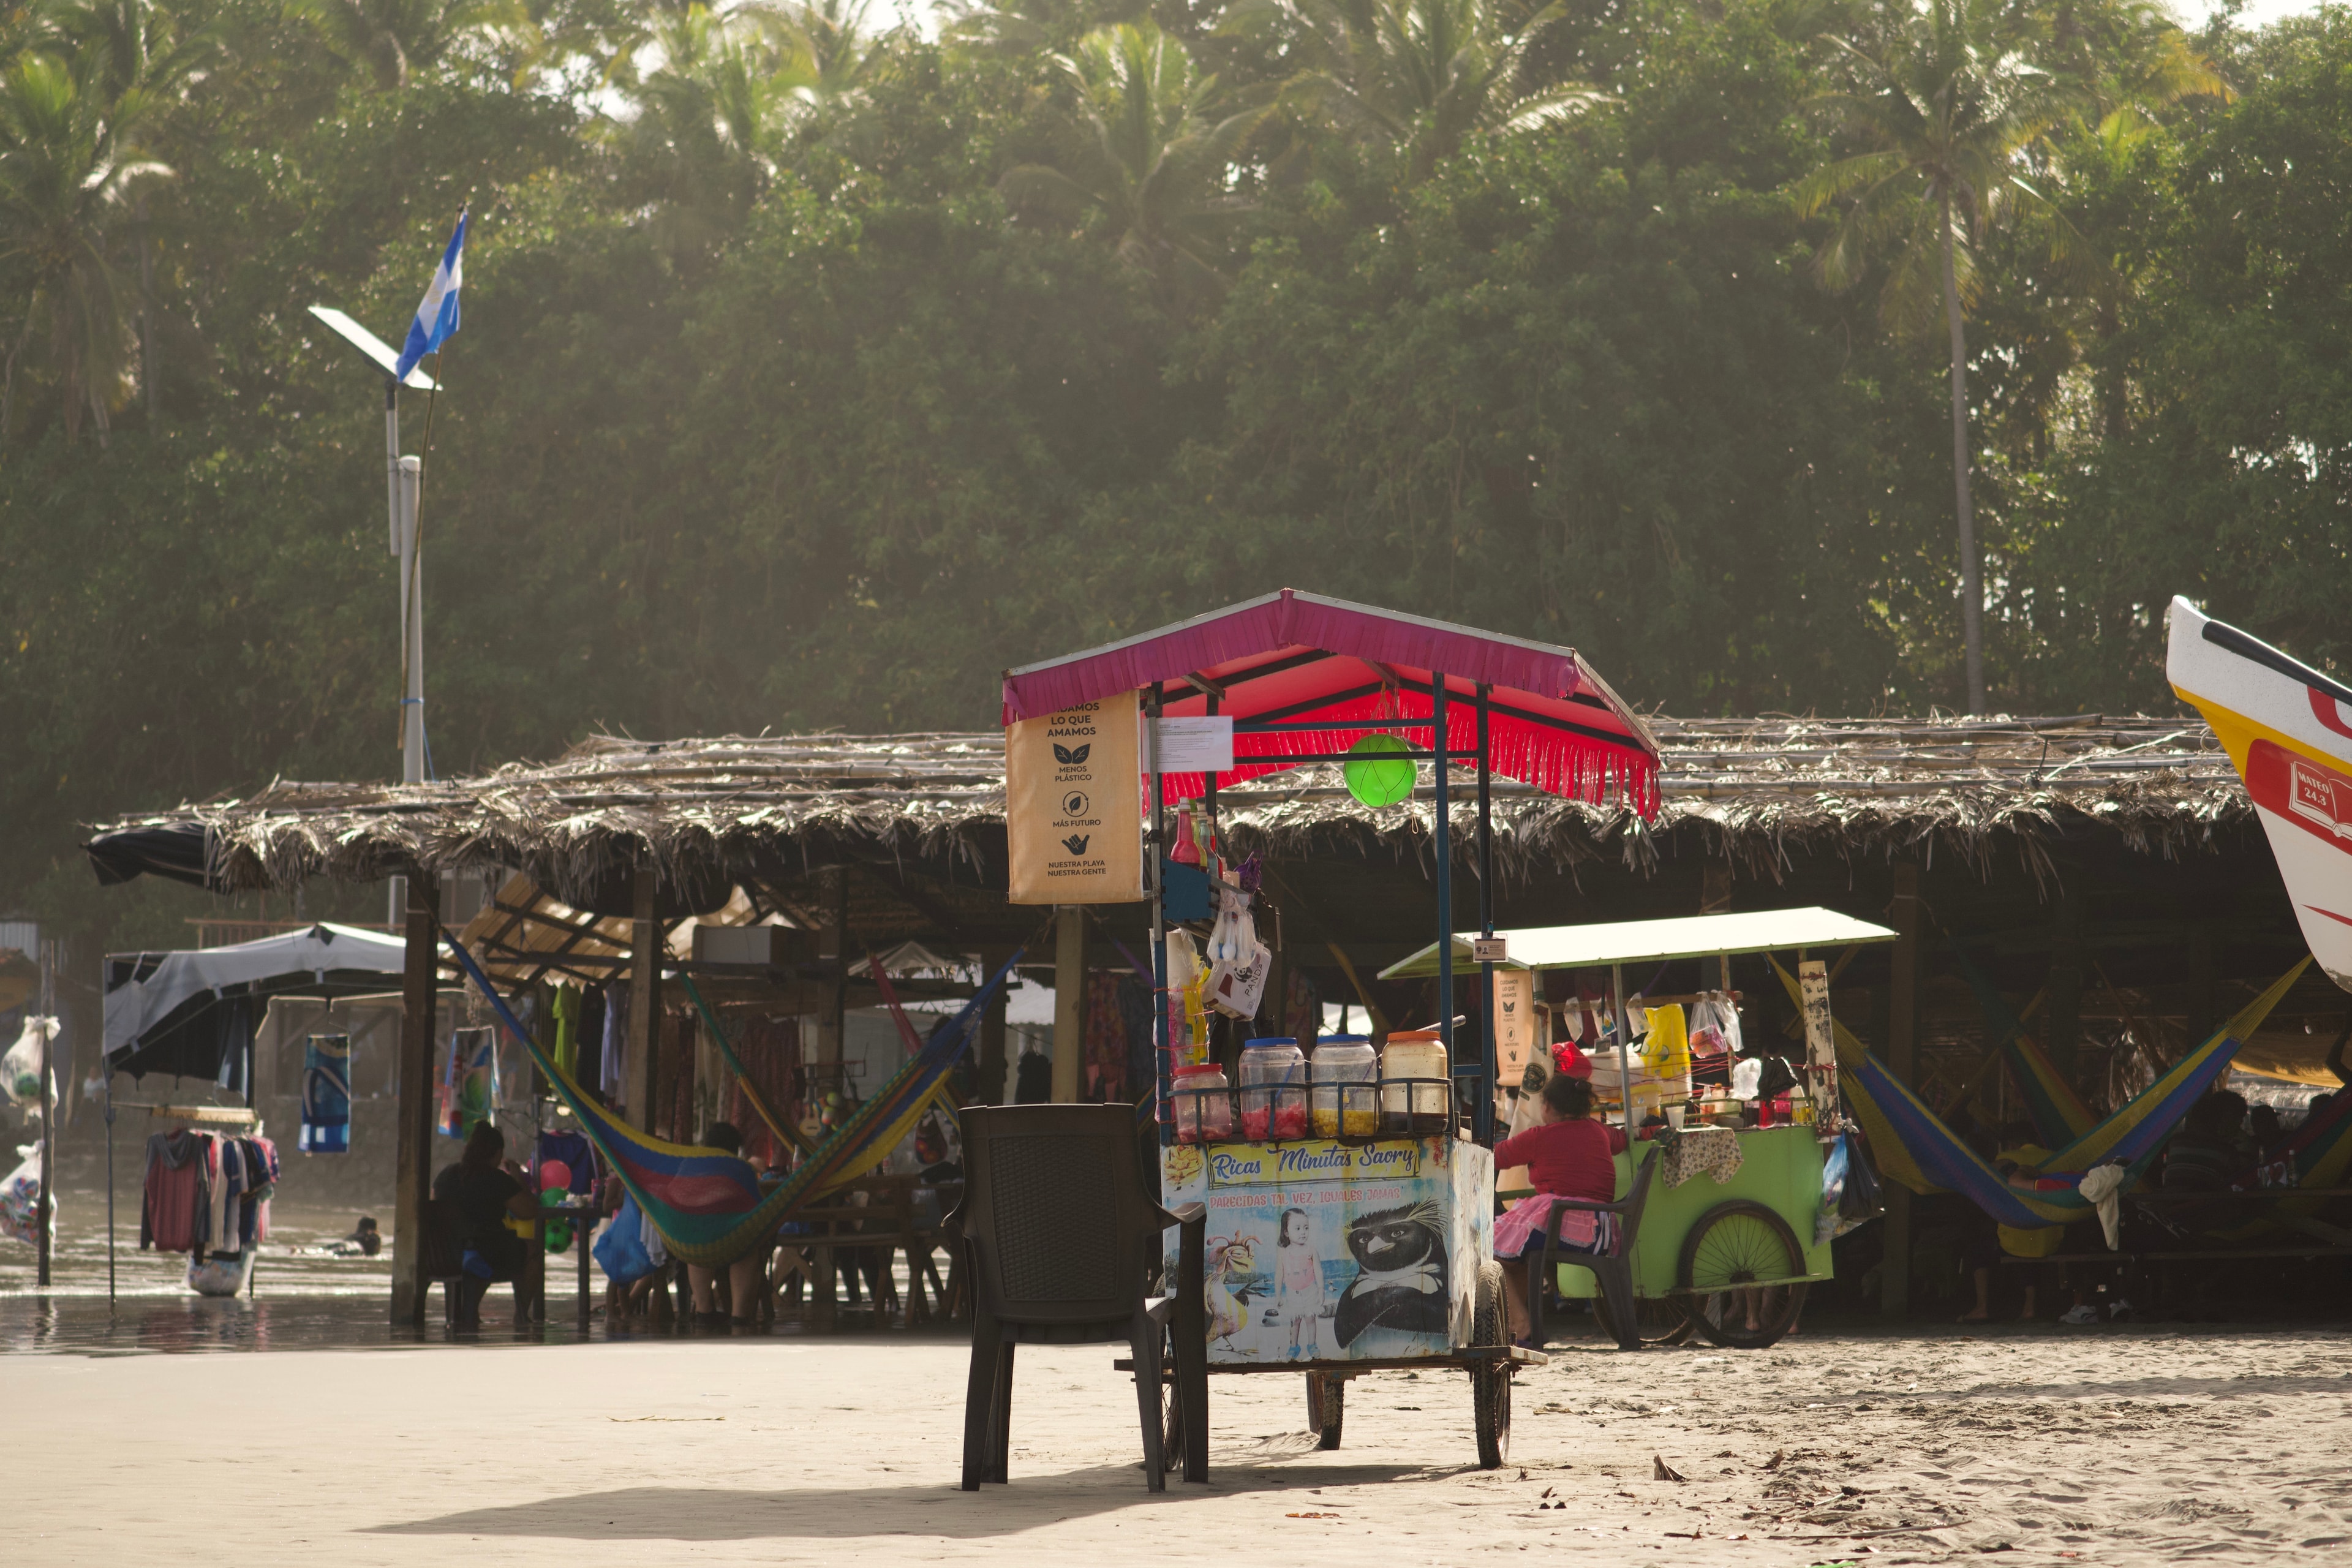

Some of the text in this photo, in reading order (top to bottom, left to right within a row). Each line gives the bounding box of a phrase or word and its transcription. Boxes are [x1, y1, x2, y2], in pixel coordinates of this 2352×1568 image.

[1051, 715, 1091, 725] LO QUE
[1047, 727, 1096, 737] AMAMOS
[2298, 771, 2329, 794] MATEO
[2304, 787, 2326, 806] 24.3
[1245, 963, 1263, 997] PANDA
[1212, 1143, 1414, 1179] Ricas Minutas Saory
[1209, 1188, 1401, 1208] PARECIDAS TAL VEZ, IGUALES JAMAS
